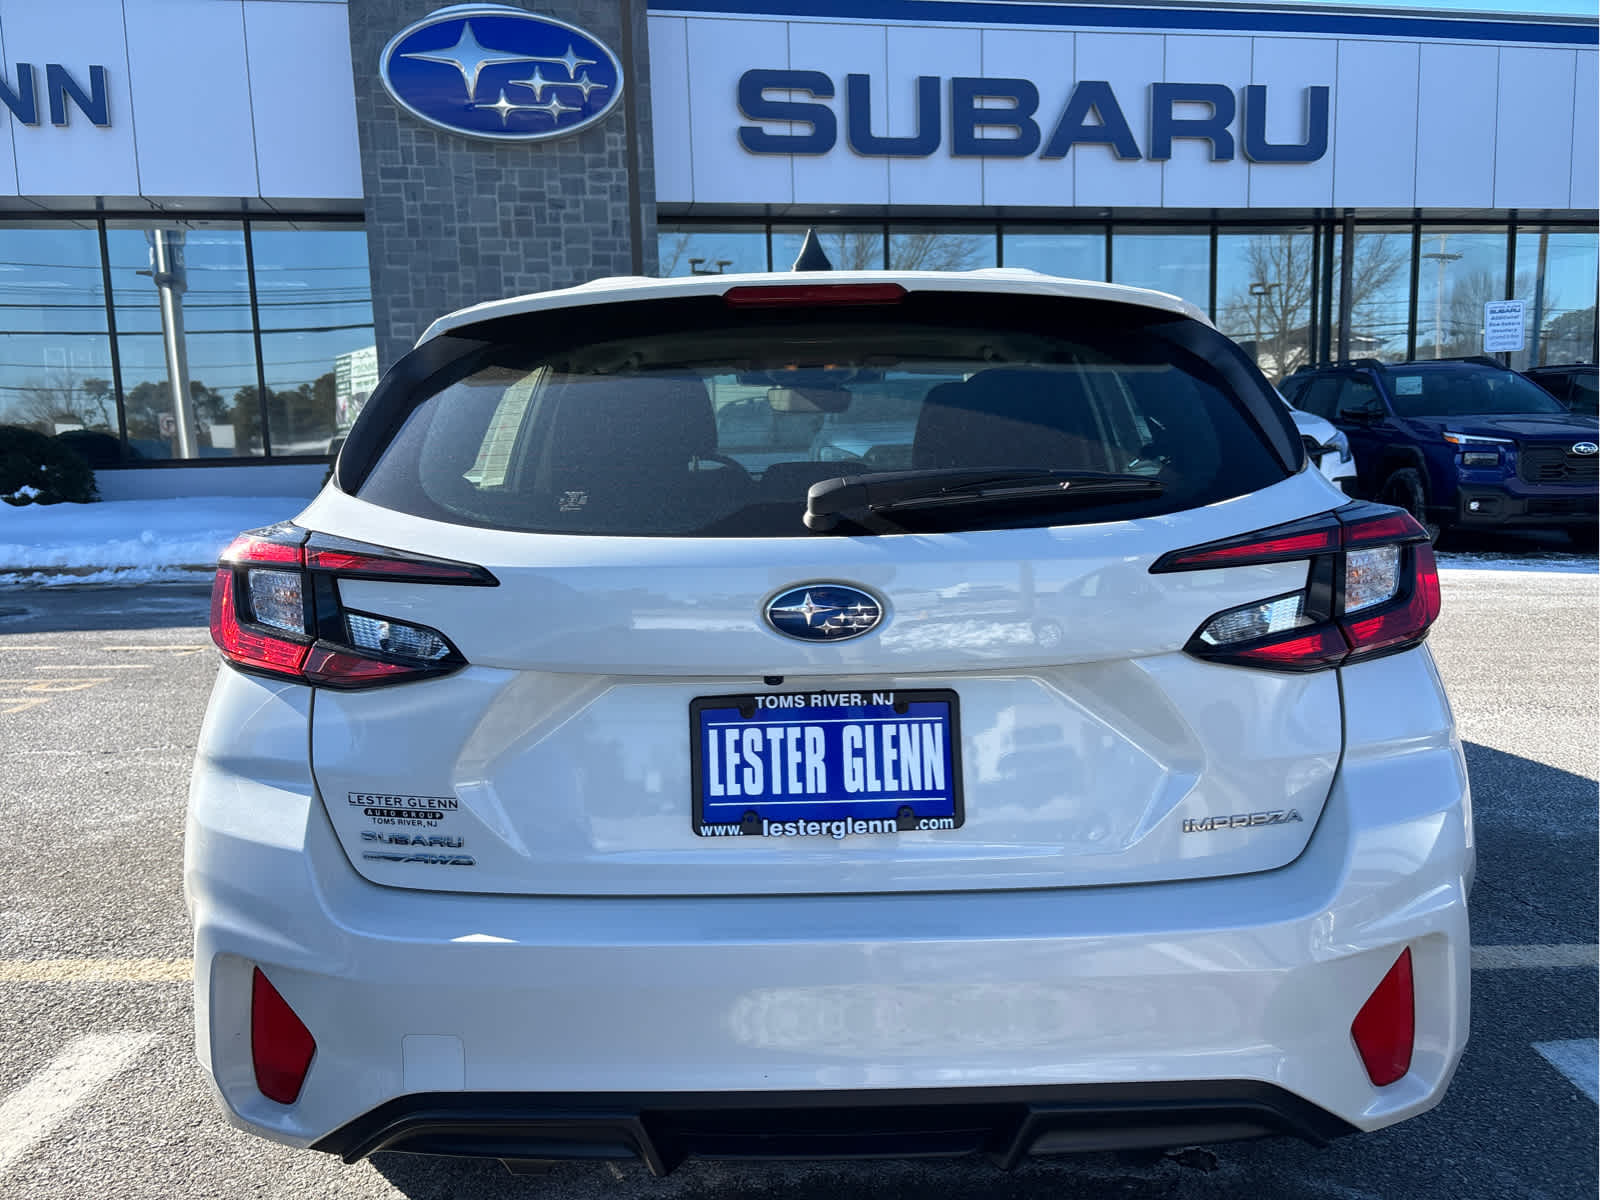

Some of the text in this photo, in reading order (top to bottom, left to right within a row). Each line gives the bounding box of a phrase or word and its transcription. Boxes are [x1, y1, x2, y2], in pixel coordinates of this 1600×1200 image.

[737, 68, 1330, 163] SUBARU
[755, 692, 895, 710] TOMS RIVER, NJ
[708, 723, 945, 796] LESTER GLENN
[348, 794, 458, 809] LESTER GLENN
[366, 809, 441, 819] AUTO GROUP
[372, 817, 438, 828] TOMS RIVER, NJ
[1182, 808, 1304, 834] IMPREZA
[762, 816, 898, 840] lesterglenn
[360, 830, 464, 848] SUBARU
